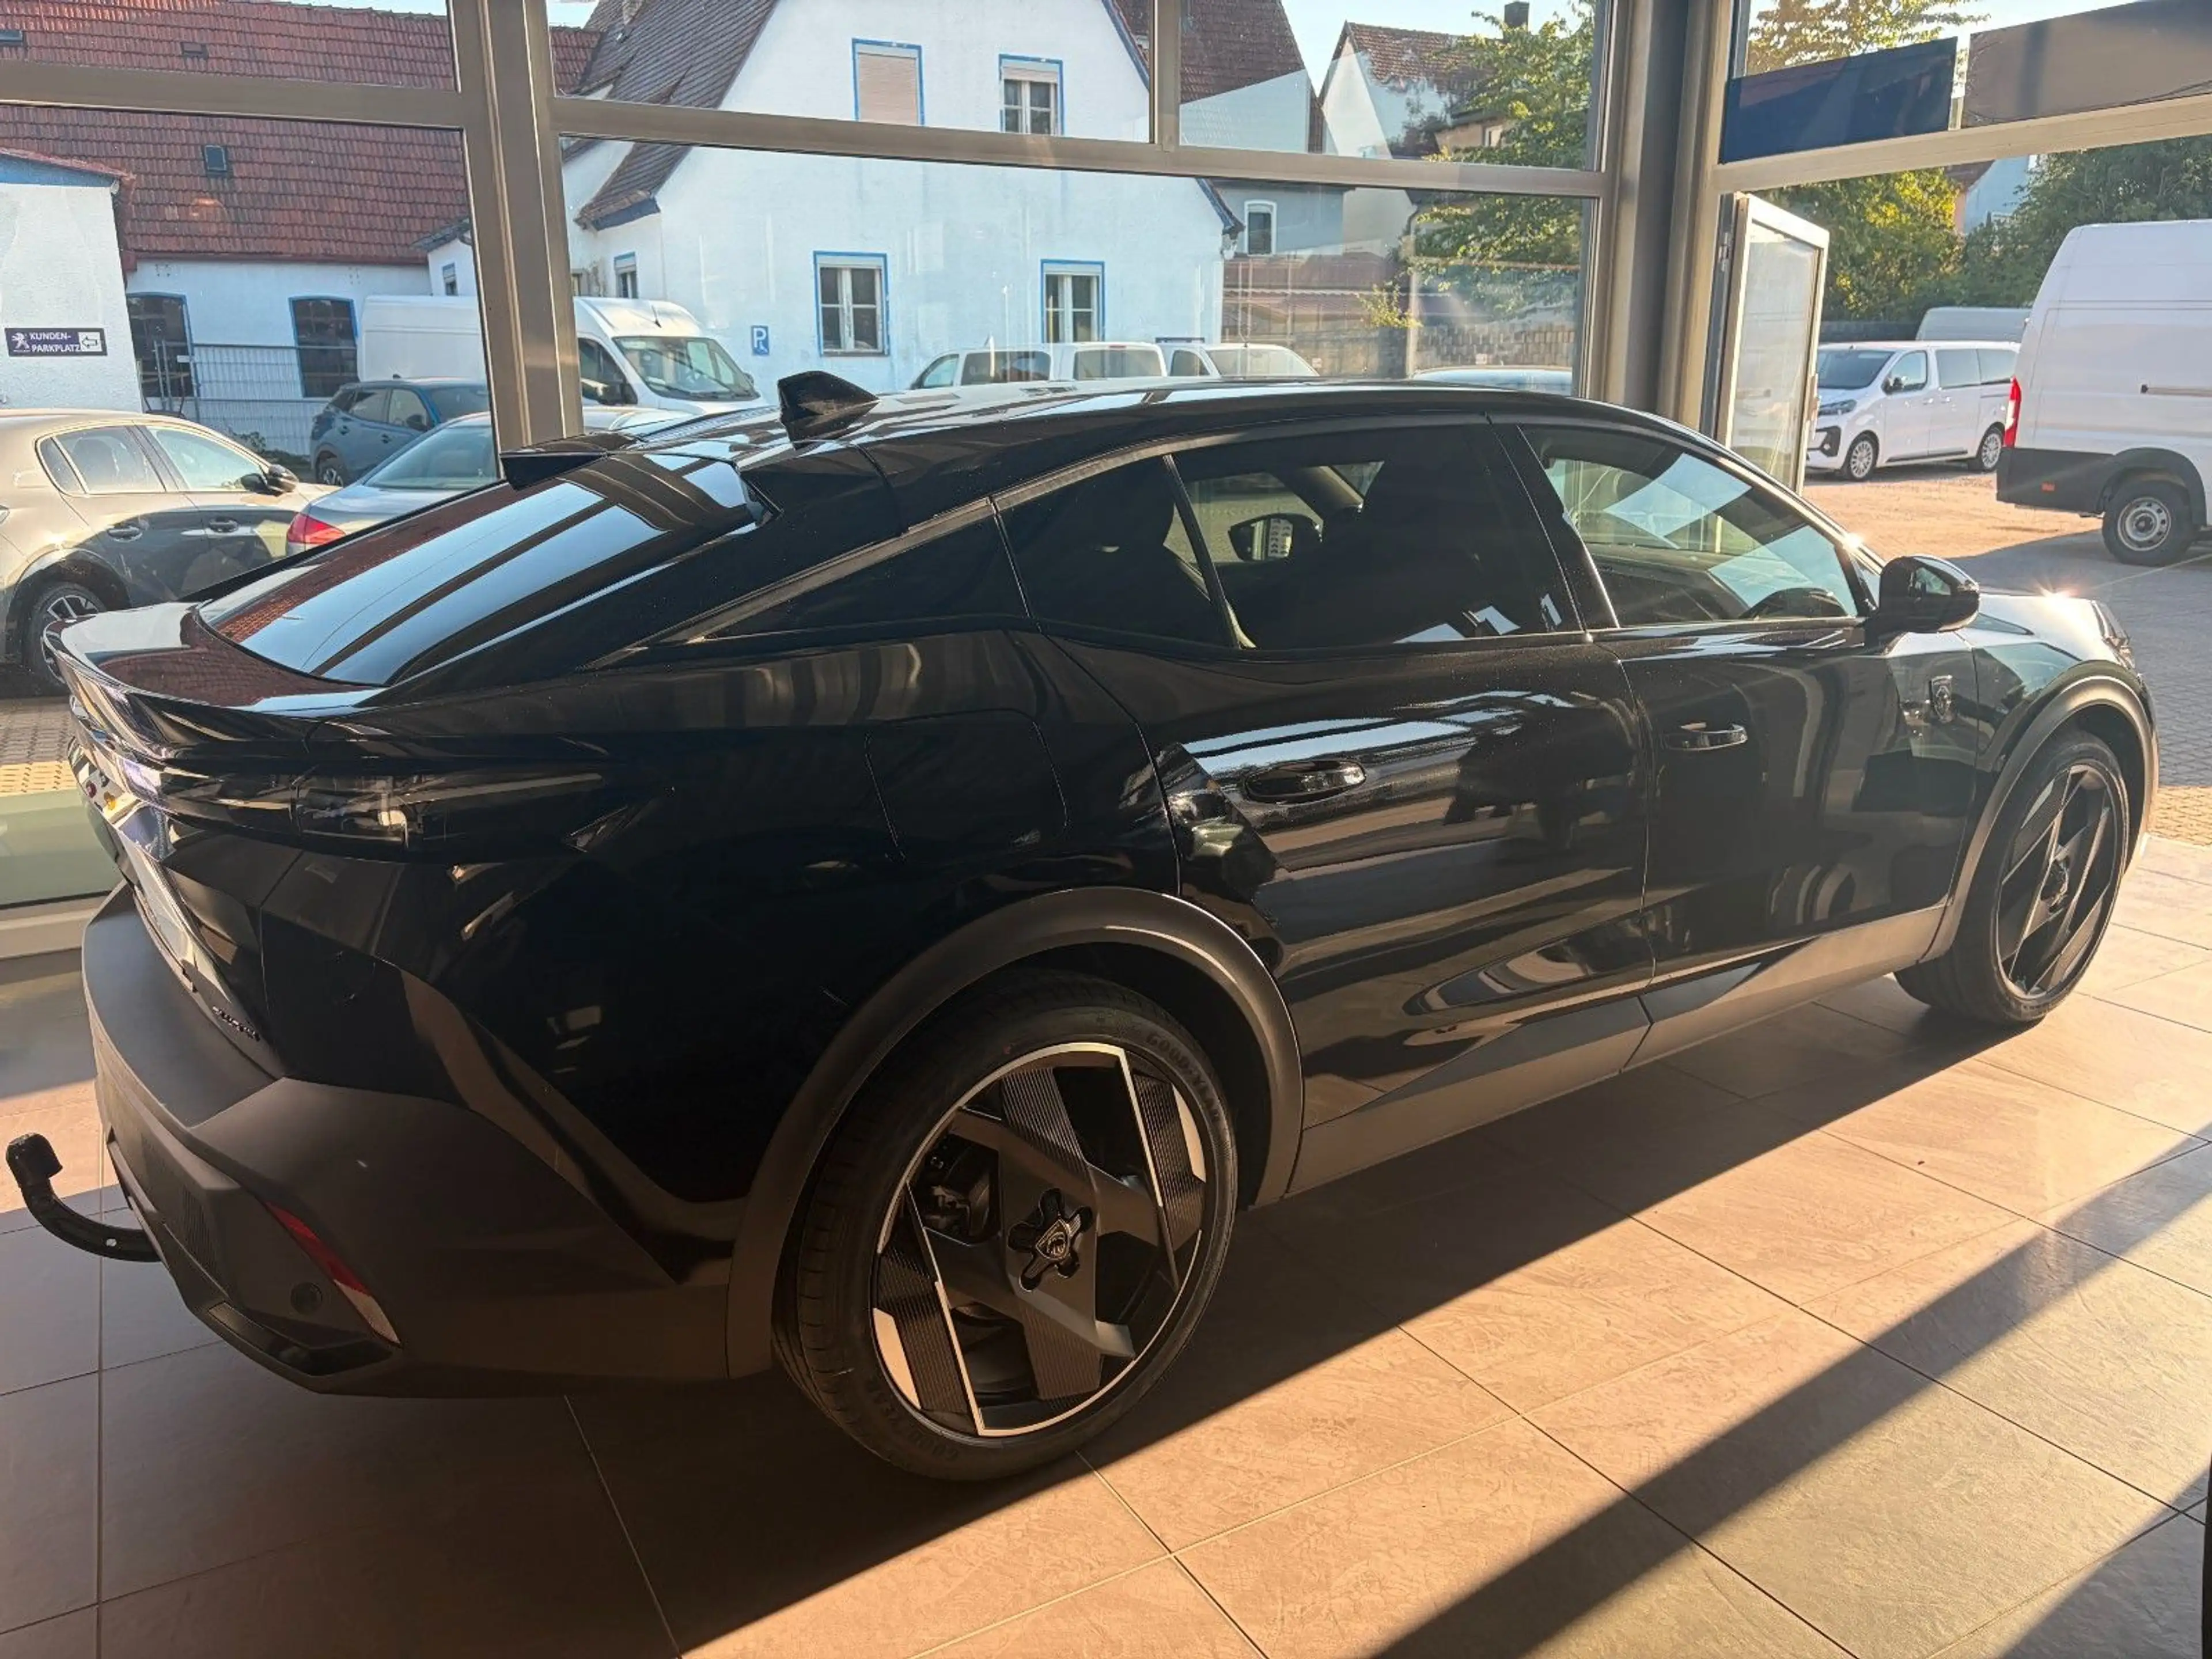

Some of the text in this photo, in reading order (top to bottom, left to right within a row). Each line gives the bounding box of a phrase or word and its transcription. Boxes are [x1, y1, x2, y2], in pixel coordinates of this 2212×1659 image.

[29, 332, 72, 340] KUNDEN-
[753, 328, 767, 348] P
[32, 344, 81, 353] PARKPLATZ
